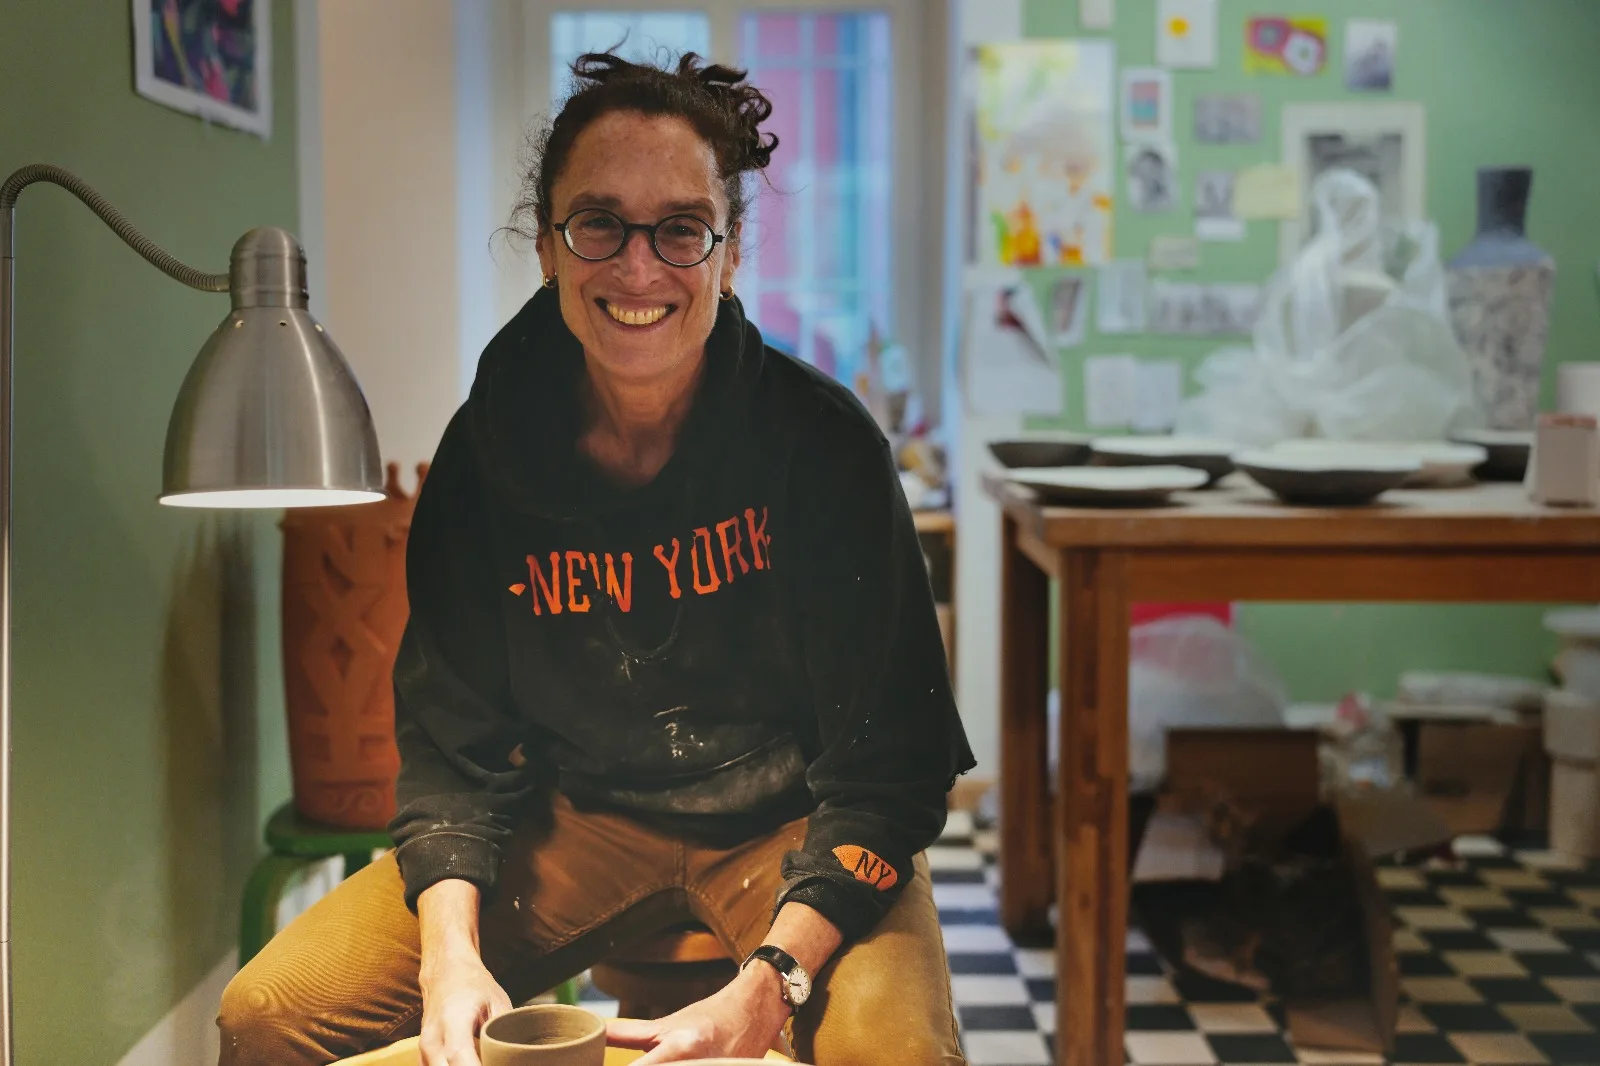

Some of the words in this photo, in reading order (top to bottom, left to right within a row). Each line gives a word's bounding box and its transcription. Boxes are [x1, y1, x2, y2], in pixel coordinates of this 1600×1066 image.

[526, 550, 633, 616] NEW
[653, 506, 771, 599] YORK
[854, 851, 892, 886] NY
